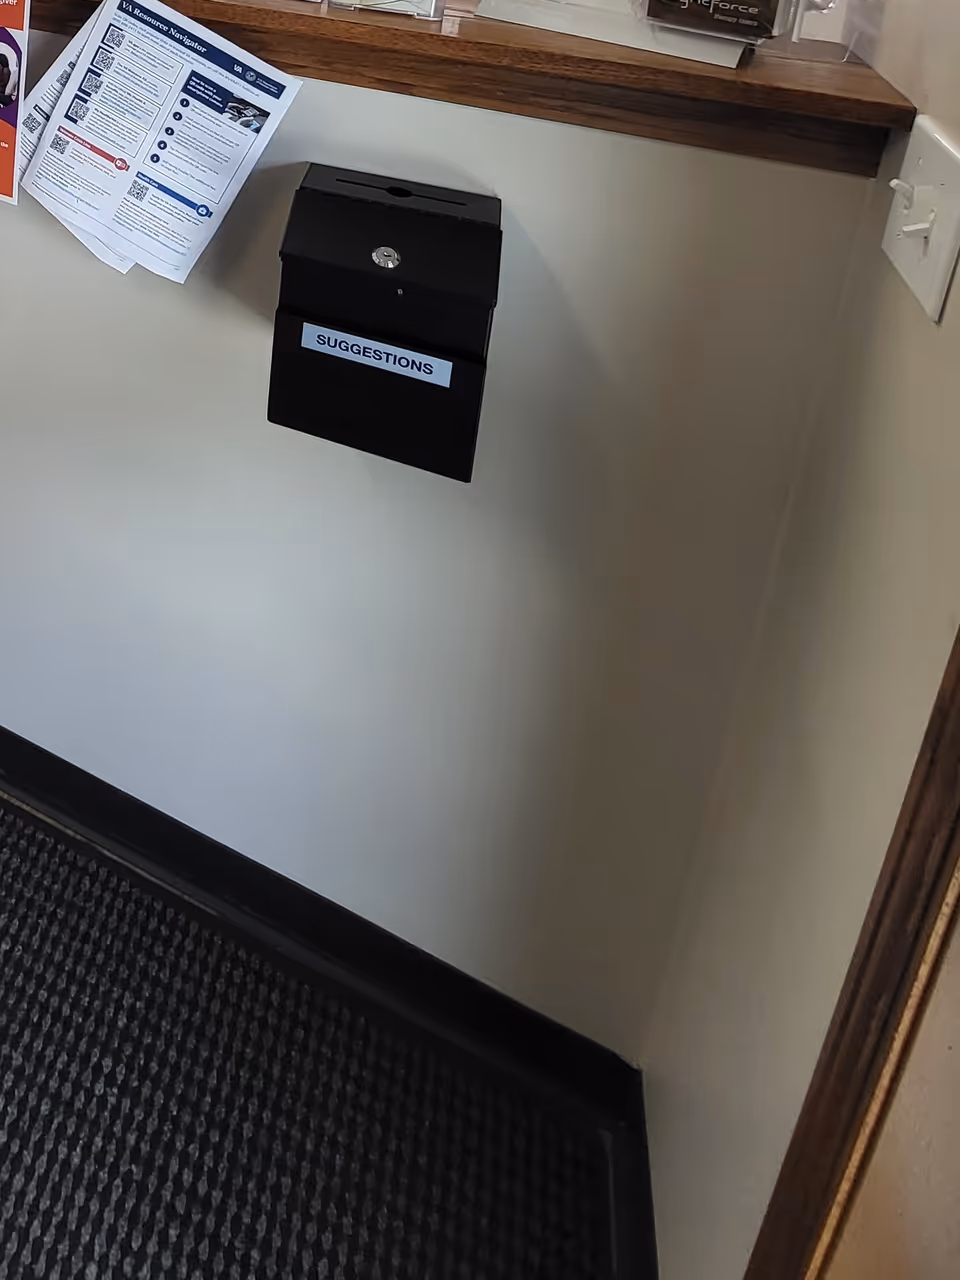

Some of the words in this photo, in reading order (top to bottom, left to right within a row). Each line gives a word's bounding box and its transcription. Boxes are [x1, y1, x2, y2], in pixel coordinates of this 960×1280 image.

[121, 0, 133, 12] VA
[133, 7, 169, 32] Resource
[169, 27, 207, 53] Navigator
[233, 64, 242, 74] VA
[316, 334, 433, 375] SUGGESTIONS
